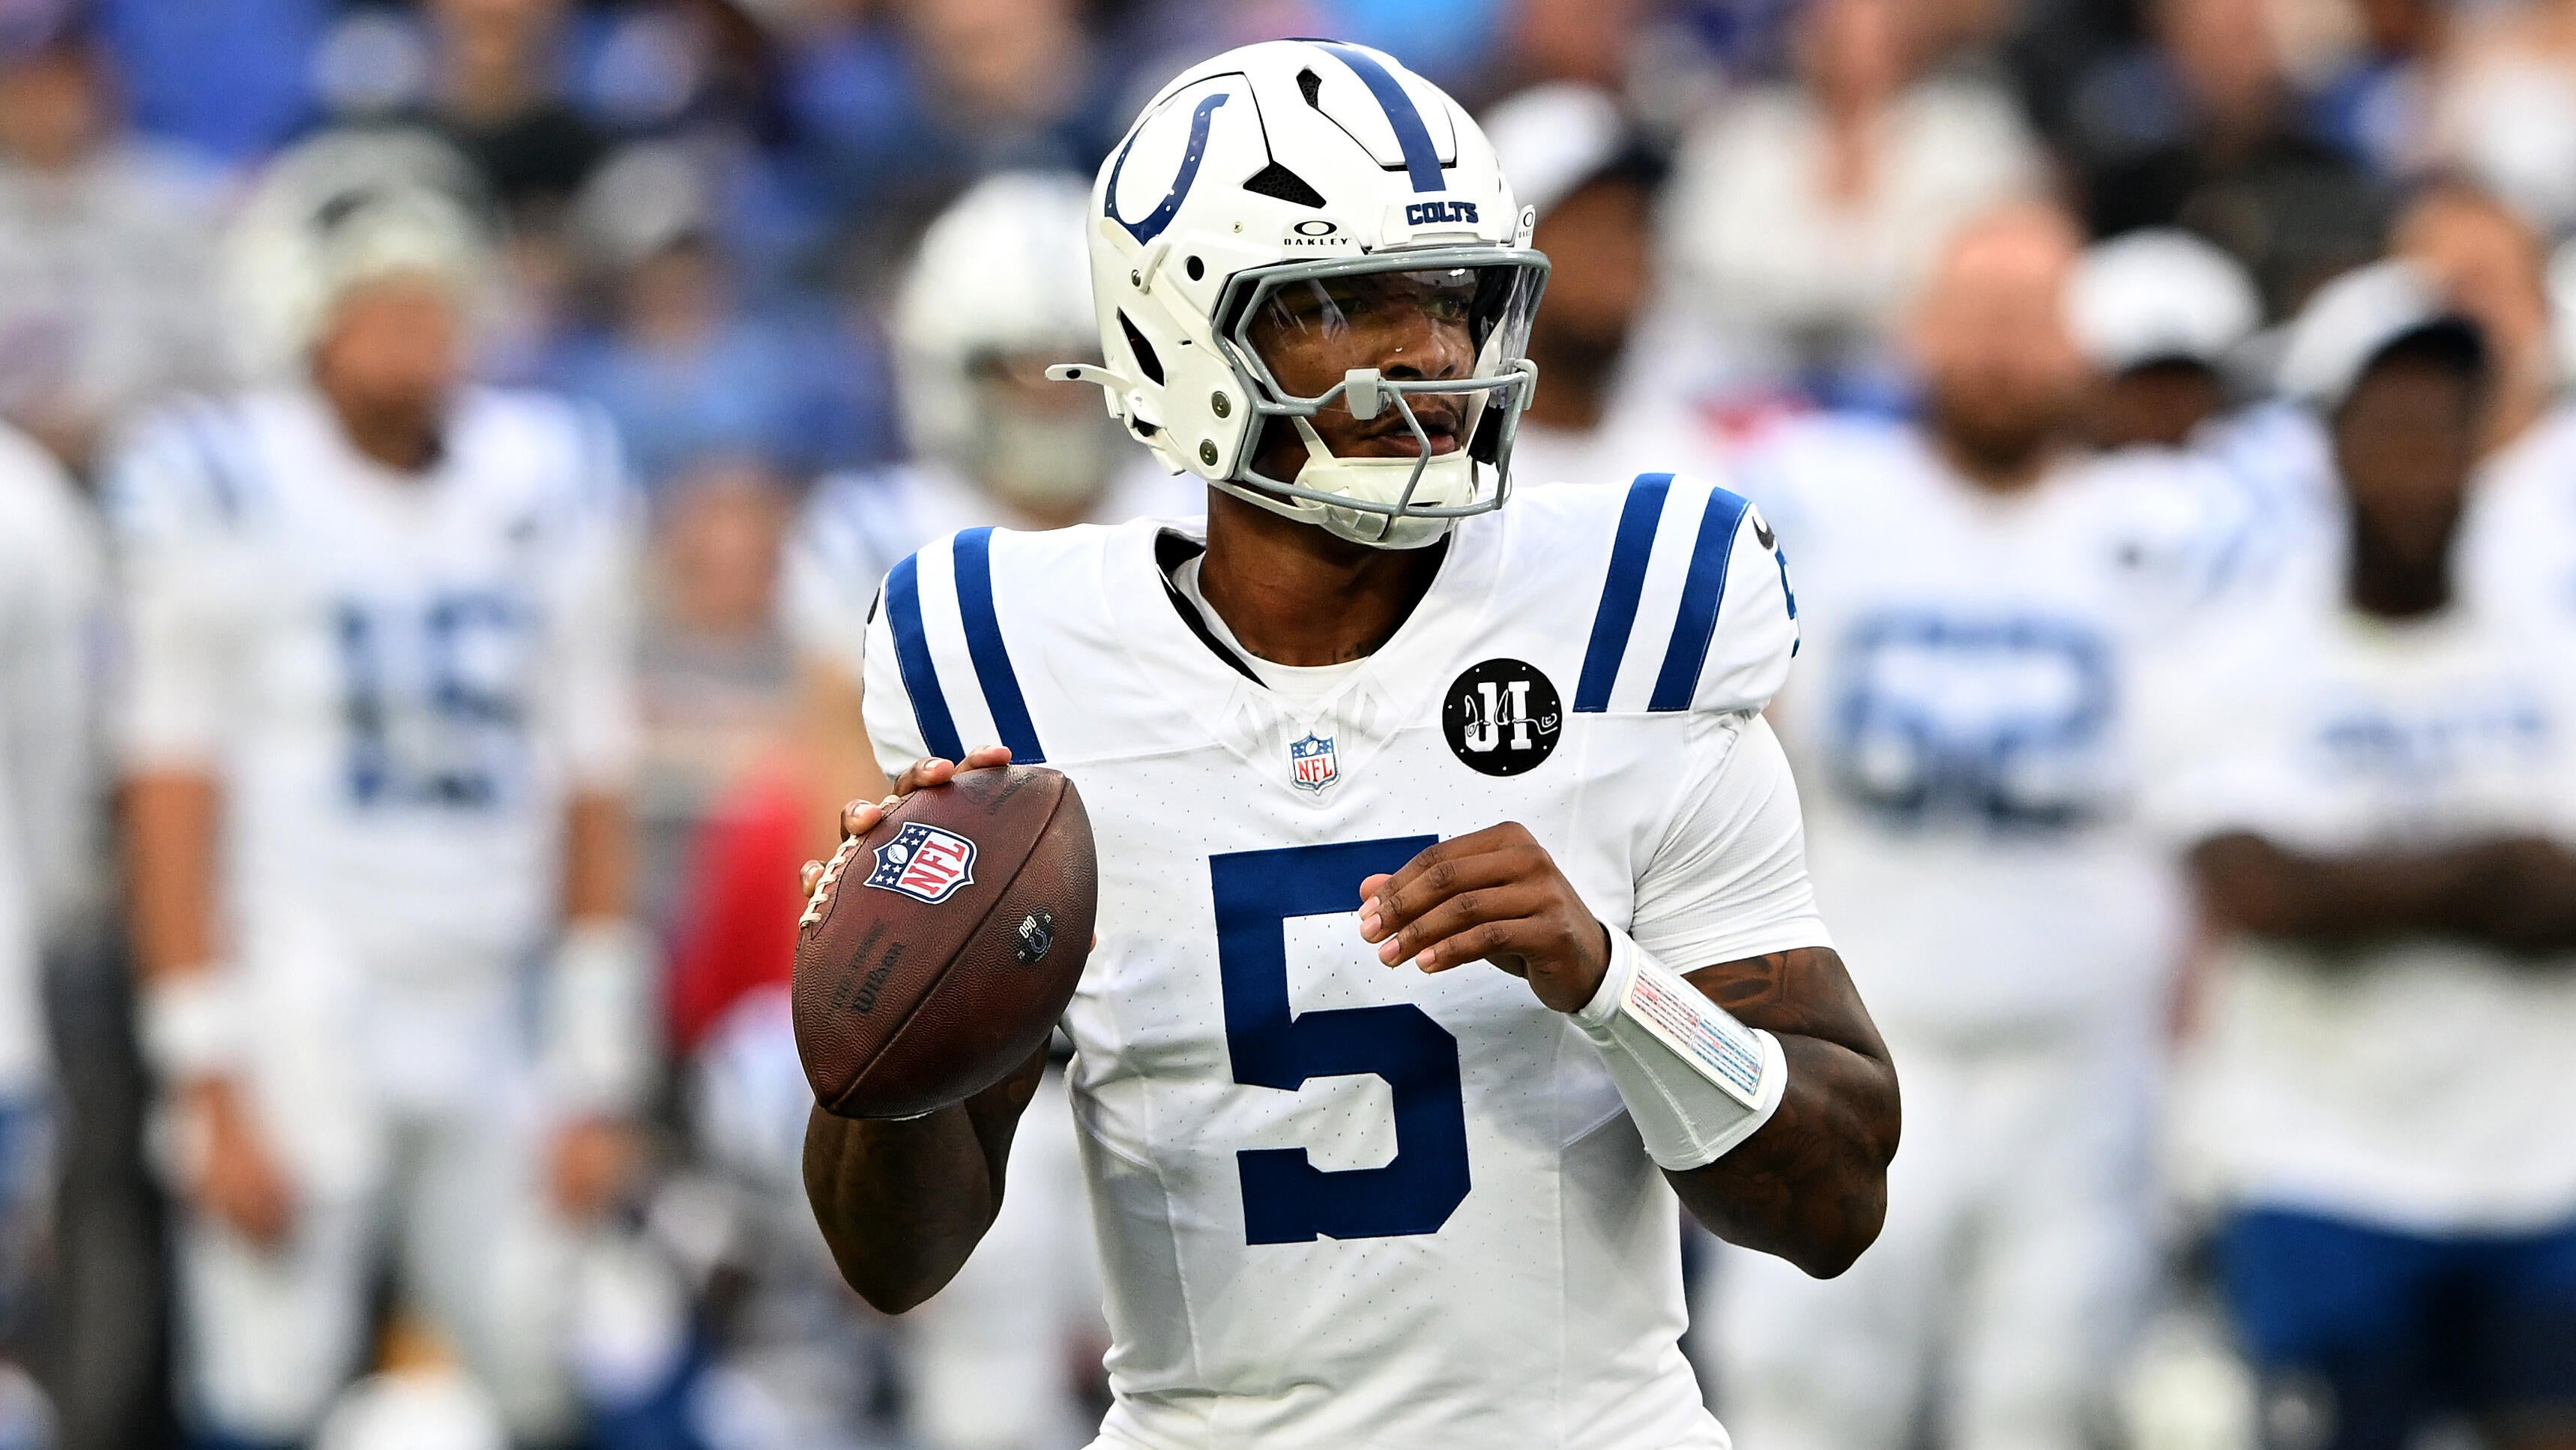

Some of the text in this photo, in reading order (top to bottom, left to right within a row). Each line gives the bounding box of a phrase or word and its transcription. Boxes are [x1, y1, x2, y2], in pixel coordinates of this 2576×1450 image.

[1406, 202, 1479, 226] COLTS
[1284, 238, 1348, 246] OAKLEY
[1297, 757, 1333, 782] NFL
[901, 840, 966, 895] NFL
[1019, 915, 1037, 939] 090
[853, 942, 905, 1014] Wilson
[1208, 834, 1472, 1245] 5
